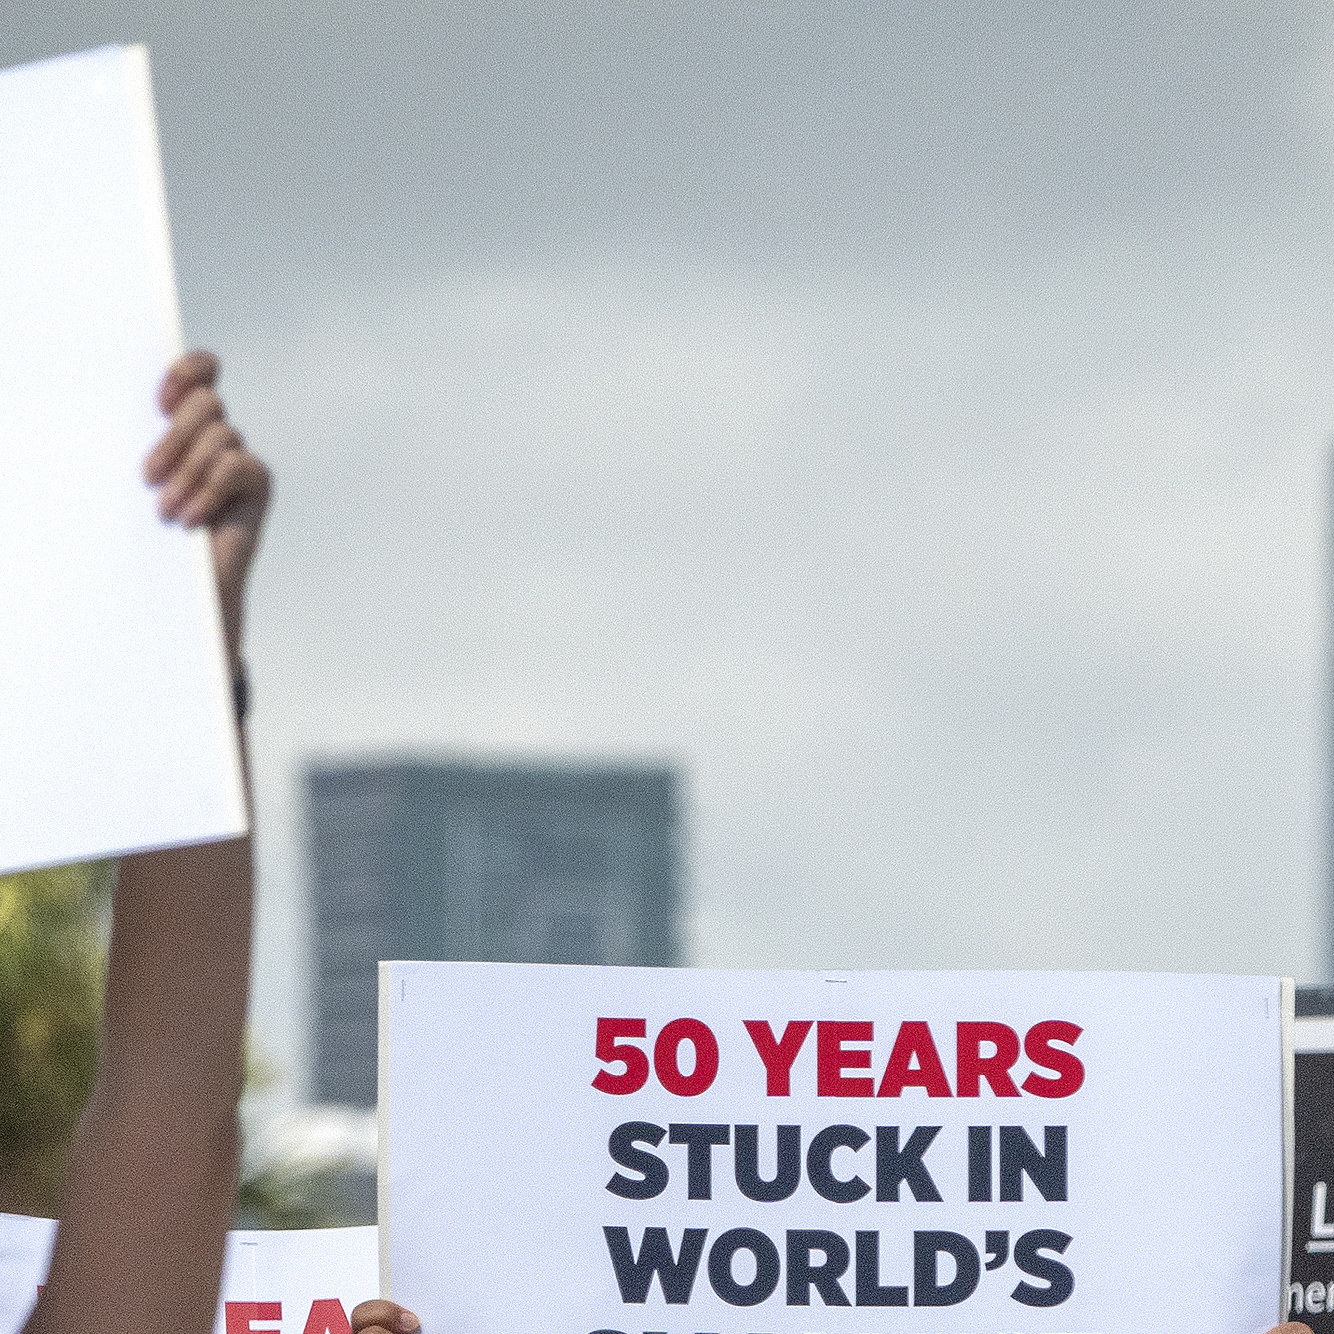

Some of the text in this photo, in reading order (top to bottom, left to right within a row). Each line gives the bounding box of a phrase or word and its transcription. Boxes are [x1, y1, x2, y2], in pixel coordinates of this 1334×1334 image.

[591, 1016, 1086, 1099] 50 YEARS
[604, 1121, 1068, 1203] STUCK IN
[603, 1226, 1075, 1307] WORLD’S
